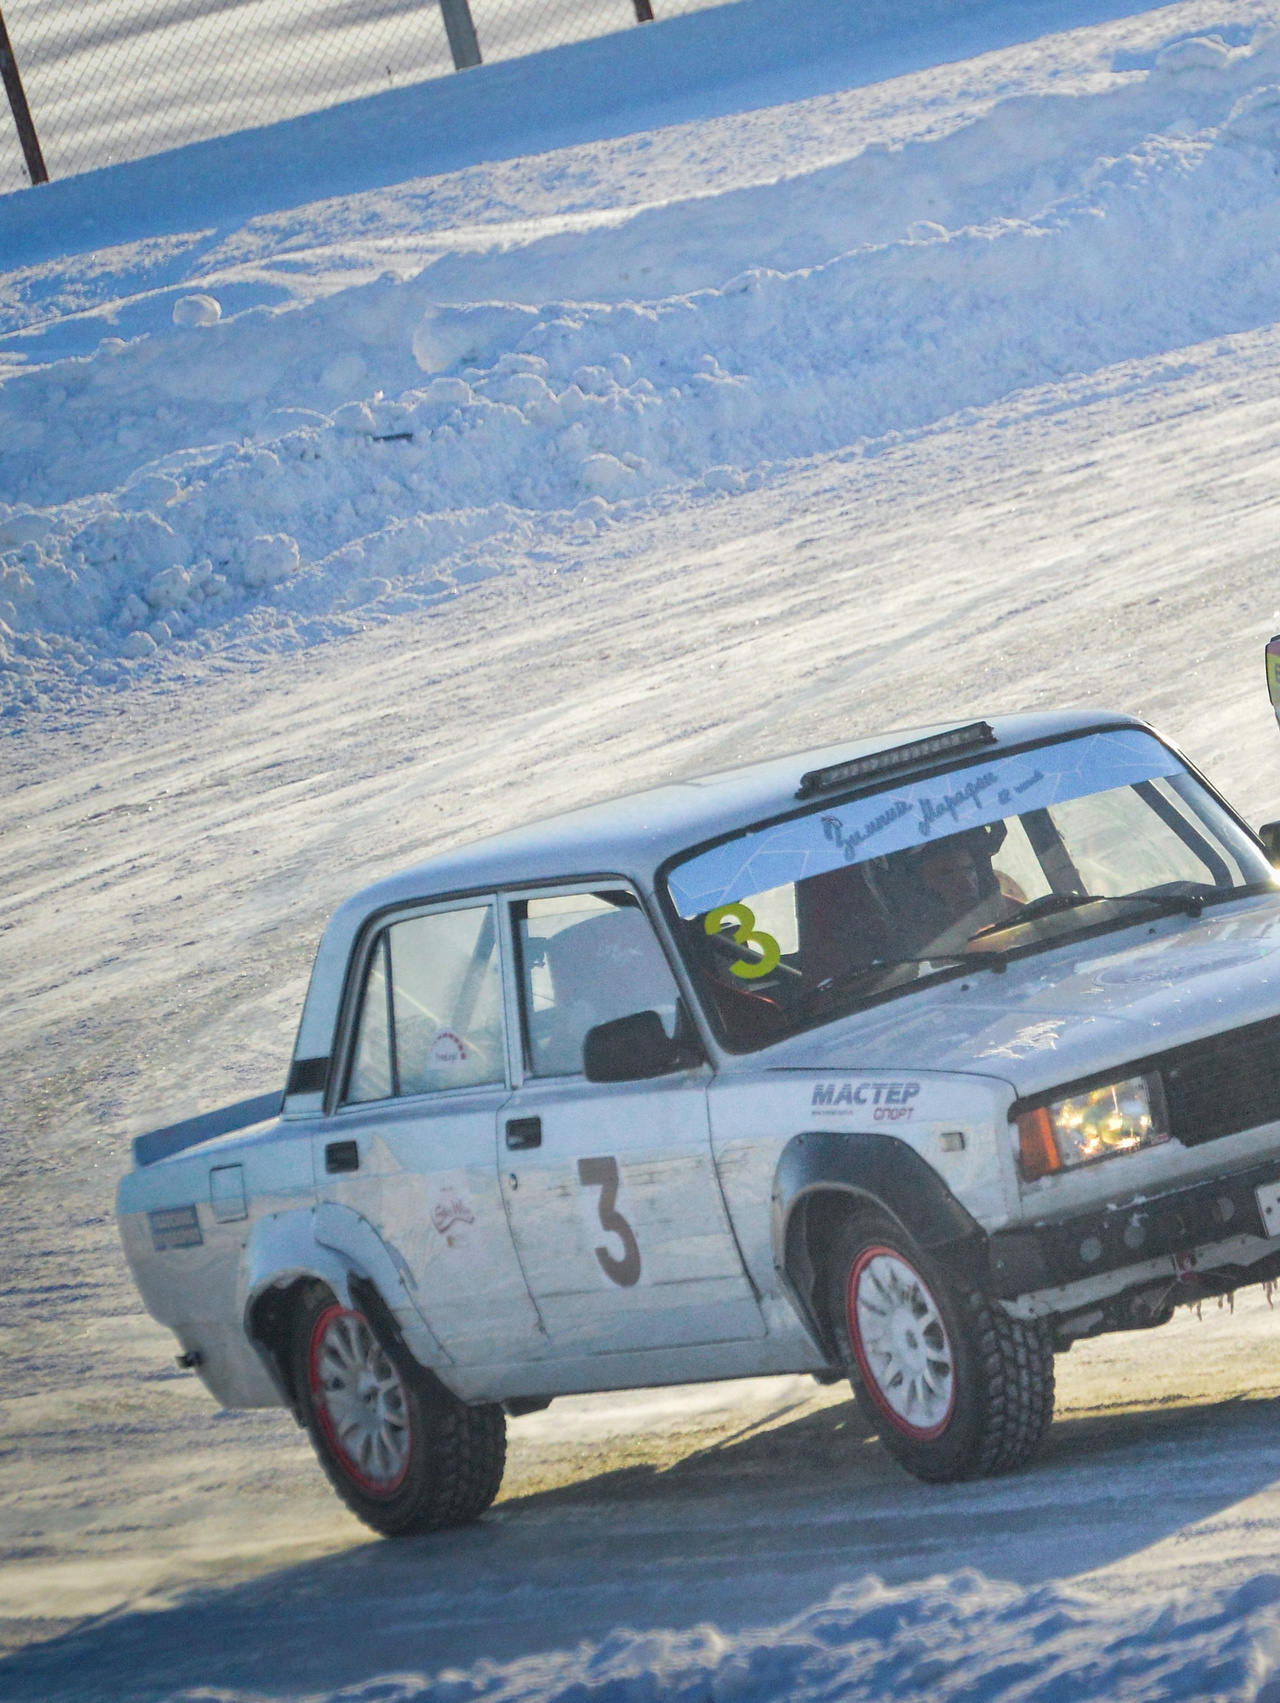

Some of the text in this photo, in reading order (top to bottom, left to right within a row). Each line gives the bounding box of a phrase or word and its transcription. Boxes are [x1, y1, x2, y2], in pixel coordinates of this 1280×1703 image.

[704, 902, 781, 979] 3
[811, 1082, 921, 1105] МАСТЕР
[578, 1156, 641, 1288] 3
